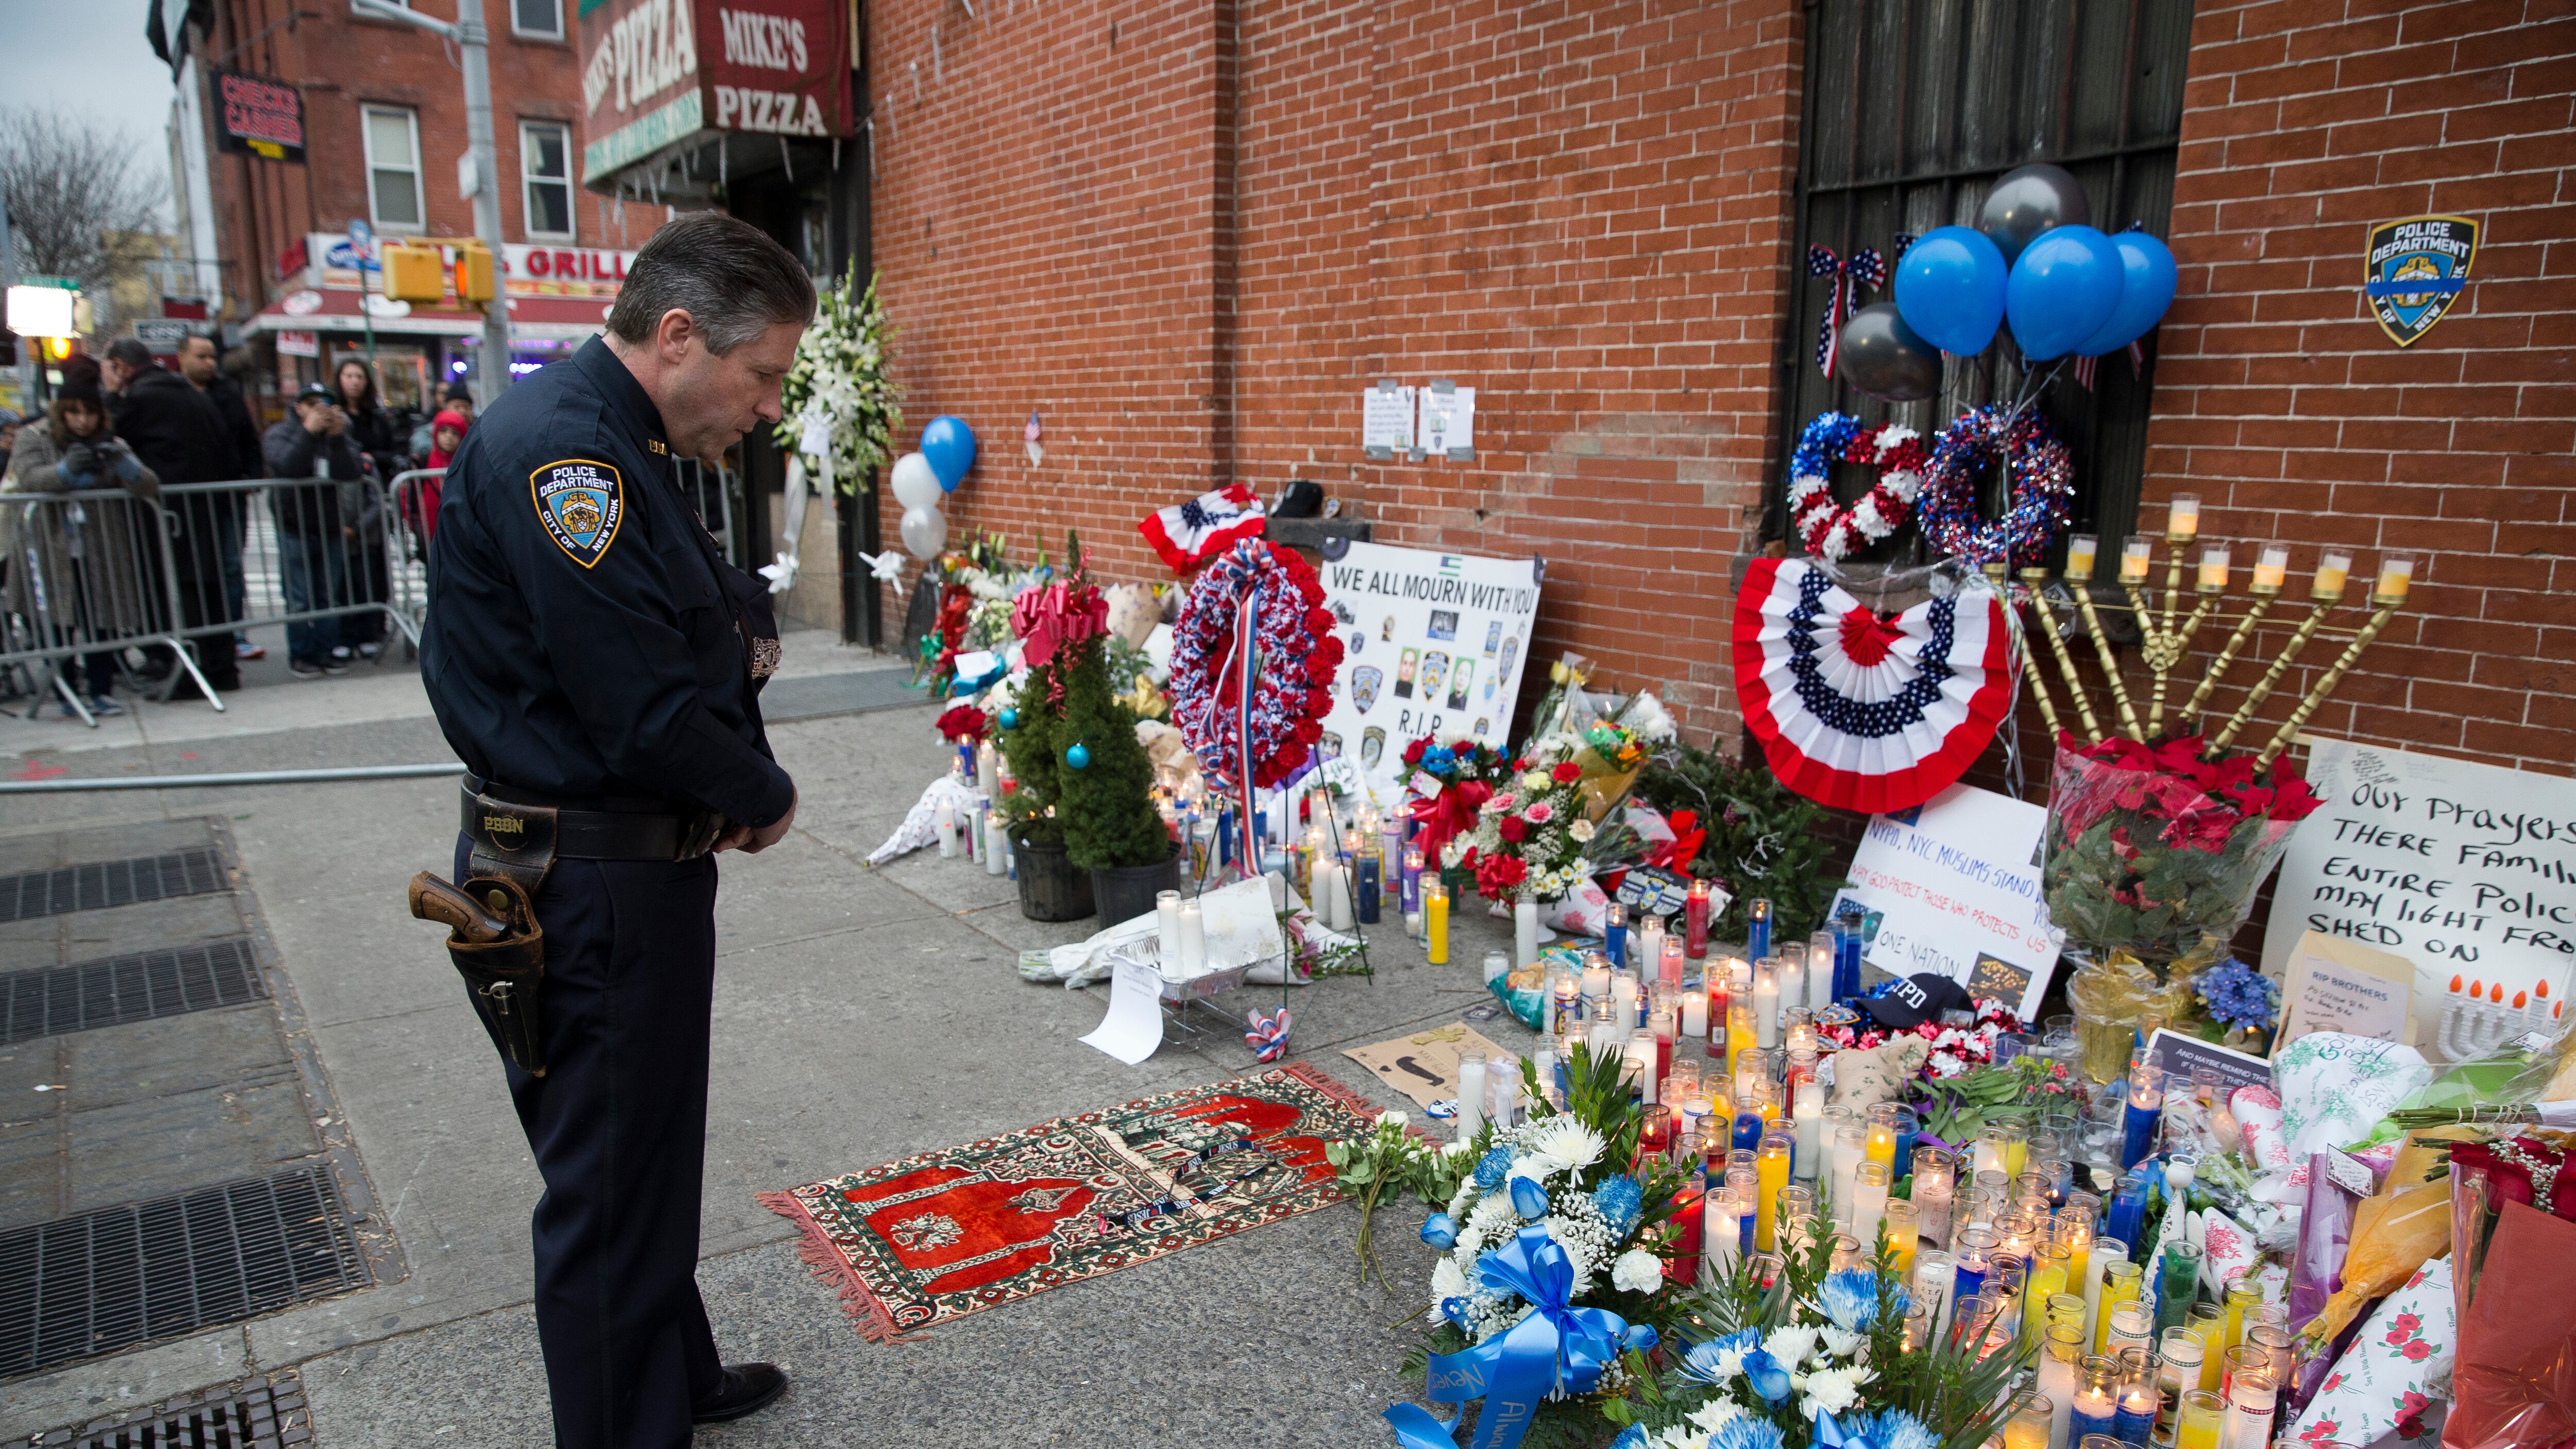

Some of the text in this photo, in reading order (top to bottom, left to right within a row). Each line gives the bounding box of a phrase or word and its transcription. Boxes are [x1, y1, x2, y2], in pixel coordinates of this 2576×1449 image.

[612, 0, 697, 113] PIZZA
[720, 7, 808, 74] MIKE'S
[221, 74, 298, 115] CHECKS
[714, 85, 828, 137] PIZZA
[225, 103, 302, 144] CASHED
[2371, 236, 2470, 265] DEPARTMENT
[2394, 221, 2451, 241] POLICE
[526, 248, 627, 280] GRILL
[2370, 274, 2396, 324] CY OF
[2413, 304, 2441, 331] NEW
[540, 476, 614, 498] DEPARTMENT
[552, 466, 597, 480] POLICE
[543, 510, 576, 549] CITY OF
[592, 499, 619, 552] NEW YORK
[1332, 565, 1535, 615] WE ALL MOURN WITH YOU
[2333, 819, 2438, 856] THERE
[1907, 833, 1936, 860] NYC
[1936, 844, 1992, 882] MUSLIMS
[1991, 868, 2035, 898] STAND
[2323, 857, 2452, 898] ENTIRE
[1869, 871, 1888, 889] GOD
[1888, 877, 1921, 898] PROTECT
[1923, 889, 1949, 910] THOSE
[1951, 900, 1969, 916] WHO
[1972, 909, 2020, 940] PROTECTS
[2027, 935, 2046, 953] US
[1879, 931, 1960, 978] ONE NATION
[2308, 914, 2479, 962] SHED ON
[1892, 978, 1927, 1009] YPD
[2312, 971, 2388, 1001] RIP BROTHERS
[2175, 1048, 2269, 1083] AND MAYBE REMIND THE
[2344, 1037, 2387, 1065] BLE
[2226, 1075, 2248, 1087] THEY
